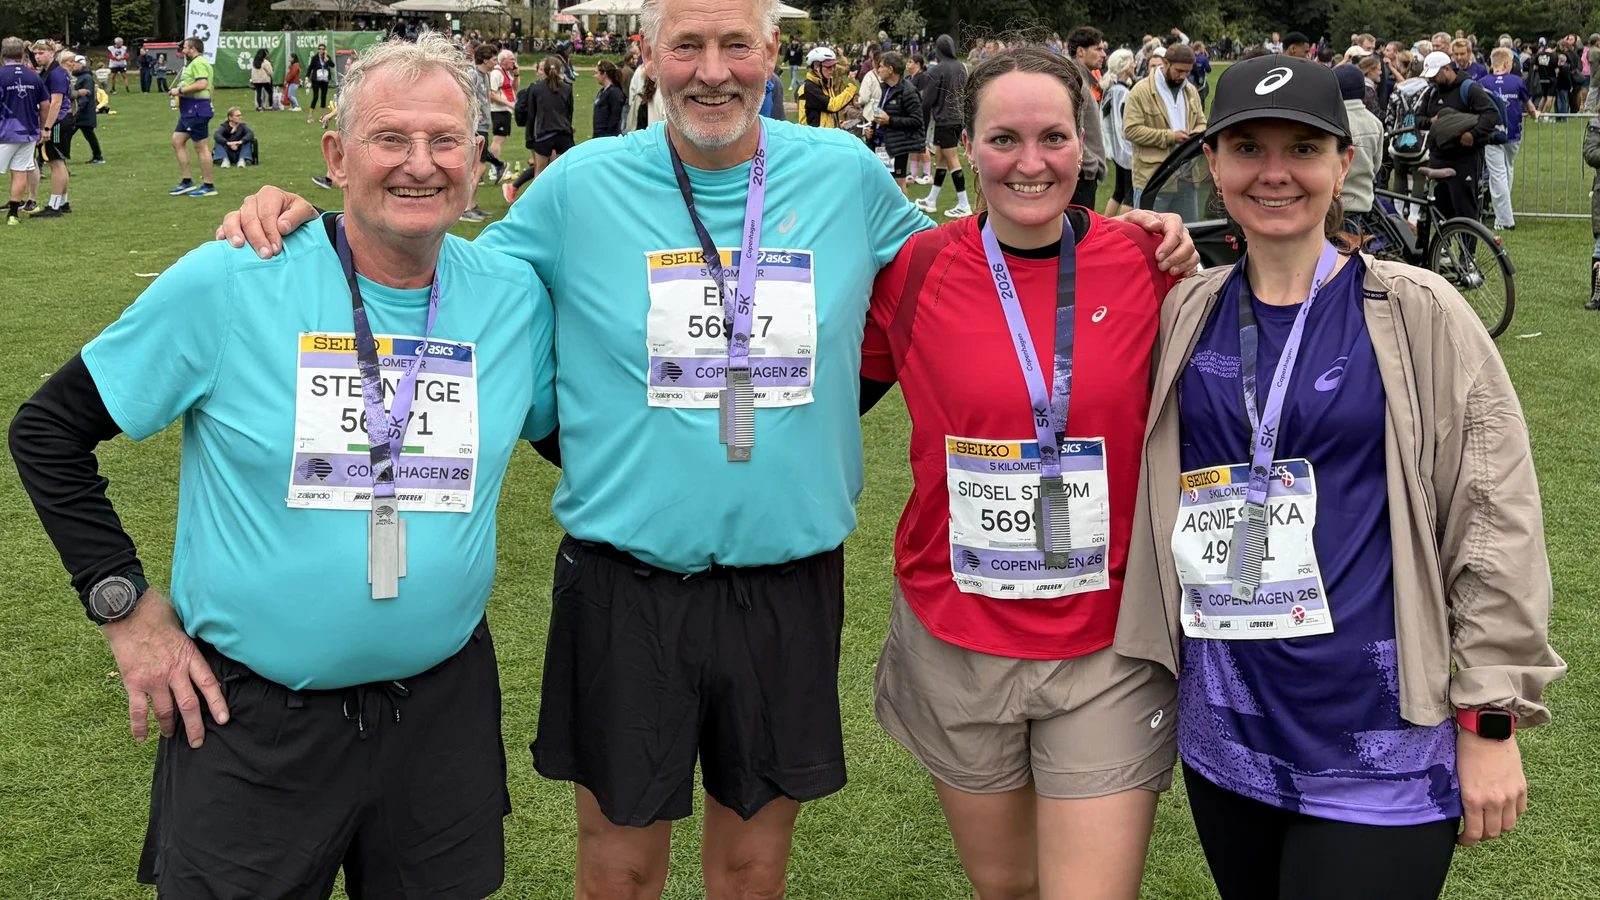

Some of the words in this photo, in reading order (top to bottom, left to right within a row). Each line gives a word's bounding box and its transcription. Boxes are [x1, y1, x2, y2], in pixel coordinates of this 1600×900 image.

[217, 36, 280, 49] ECYCLING
[753, 149, 765, 187] 2026
[746, 219, 756, 259] Copenhagen
[661, 251, 707, 266] SEIK
[992, 263, 1014, 300] 2026
[738, 294, 750, 315] 5K
[688, 315, 773, 339] 567
[313, 337, 380, 351] SEI
[1017, 333, 1033, 372] Copenhagen
[695, 366, 788, 379] COPAGEN
[790, 366, 808, 379] 26
[1195, 360, 1240, 373] AMPIONSHIPS
[1276, 347, 1293, 388] Copenhagen
[340, 407, 433, 436] 561
[1034, 407, 1049, 428] 5K
[388, 416, 404, 440] 5K
[1260, 425, 1275, 448] 5K
[459, 446, 472, 455] DEN
[956, 441, 1010, 458] SEIKO
[347, 464, 449, 480] COHAGEN
[451, 467, 469, 481] 26
[990, 461, 997, 470] 5
[997, 461, 1042, 472] KILOMET
[1186, 469, 1220, 488] SEIKO
[296, 491, 331, 500] zalando
[397, 494, 423, 502] ØBEREN
[958, 480, 1017, 501] SIDSEL
[1021, 481, 1090, 501] STØM
[1213, 486, 1249, 498] KILOME
[981, 508, 1038, 533] 569
[1181, 502, 1305, 533] AGNIEKA
[1092, 536, 1105, 544] DEN
[1087, 553, 1103, 565] 26
[1201, 537, 1276, 564] 491
[1298, 566, 1313, 575] POL
[1208, 590, 1295, 607] COPEAGEN
[1296, 587, 1319, 601] 26
